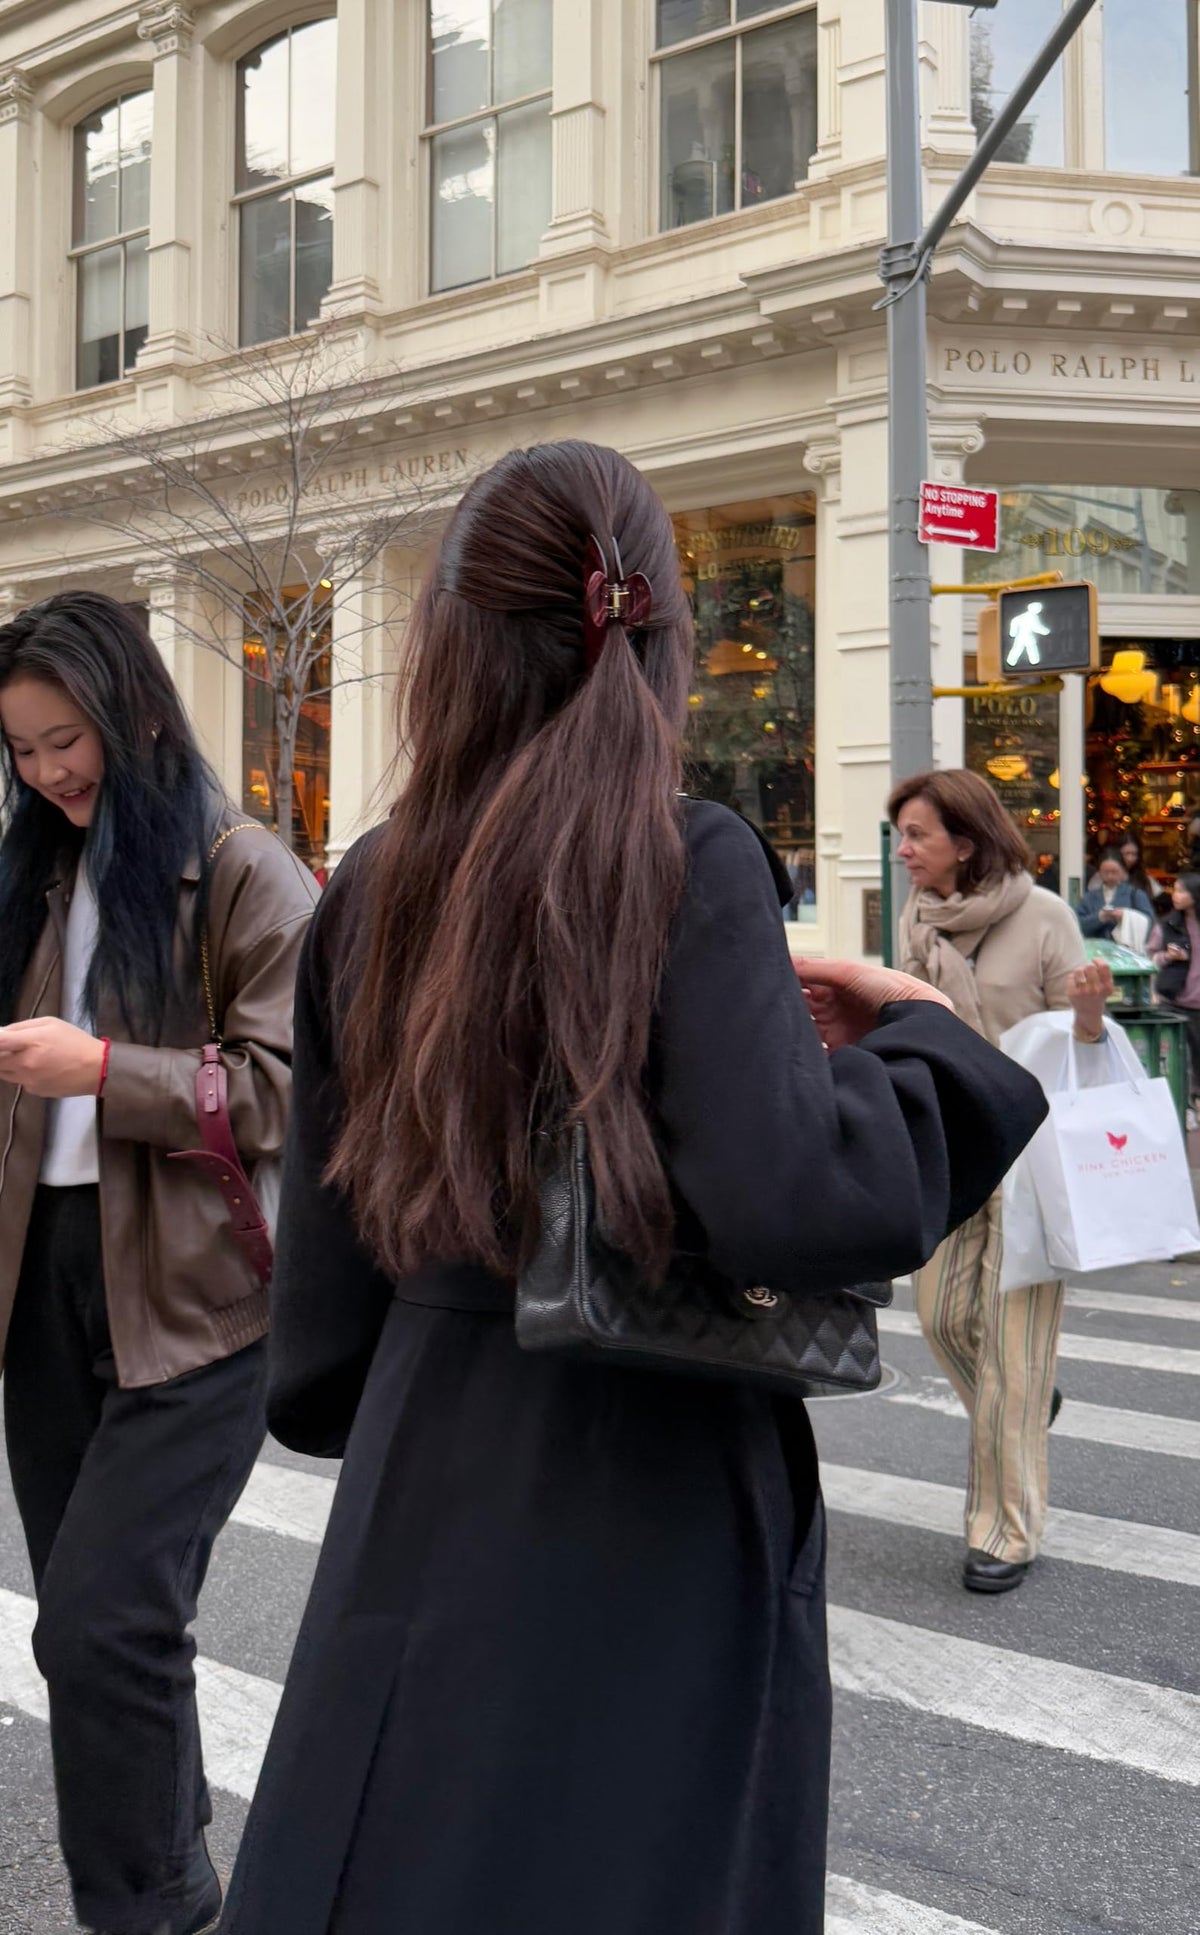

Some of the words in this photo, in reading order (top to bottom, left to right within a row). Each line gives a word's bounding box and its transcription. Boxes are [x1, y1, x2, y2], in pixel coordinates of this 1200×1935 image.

[944, 348, 1032, 376] POLO
[1050, 353, 1161, 382] RALPH
[237, 483, 288, 511] POLO
[379, 448, 468, 483] LAUREN
[925, 488, 938, 501] NO
[940, 490, 986, 508] STOPPING
[925, 502, 964, 518] Anytime
[1043, 527, 1110, 558] 109
